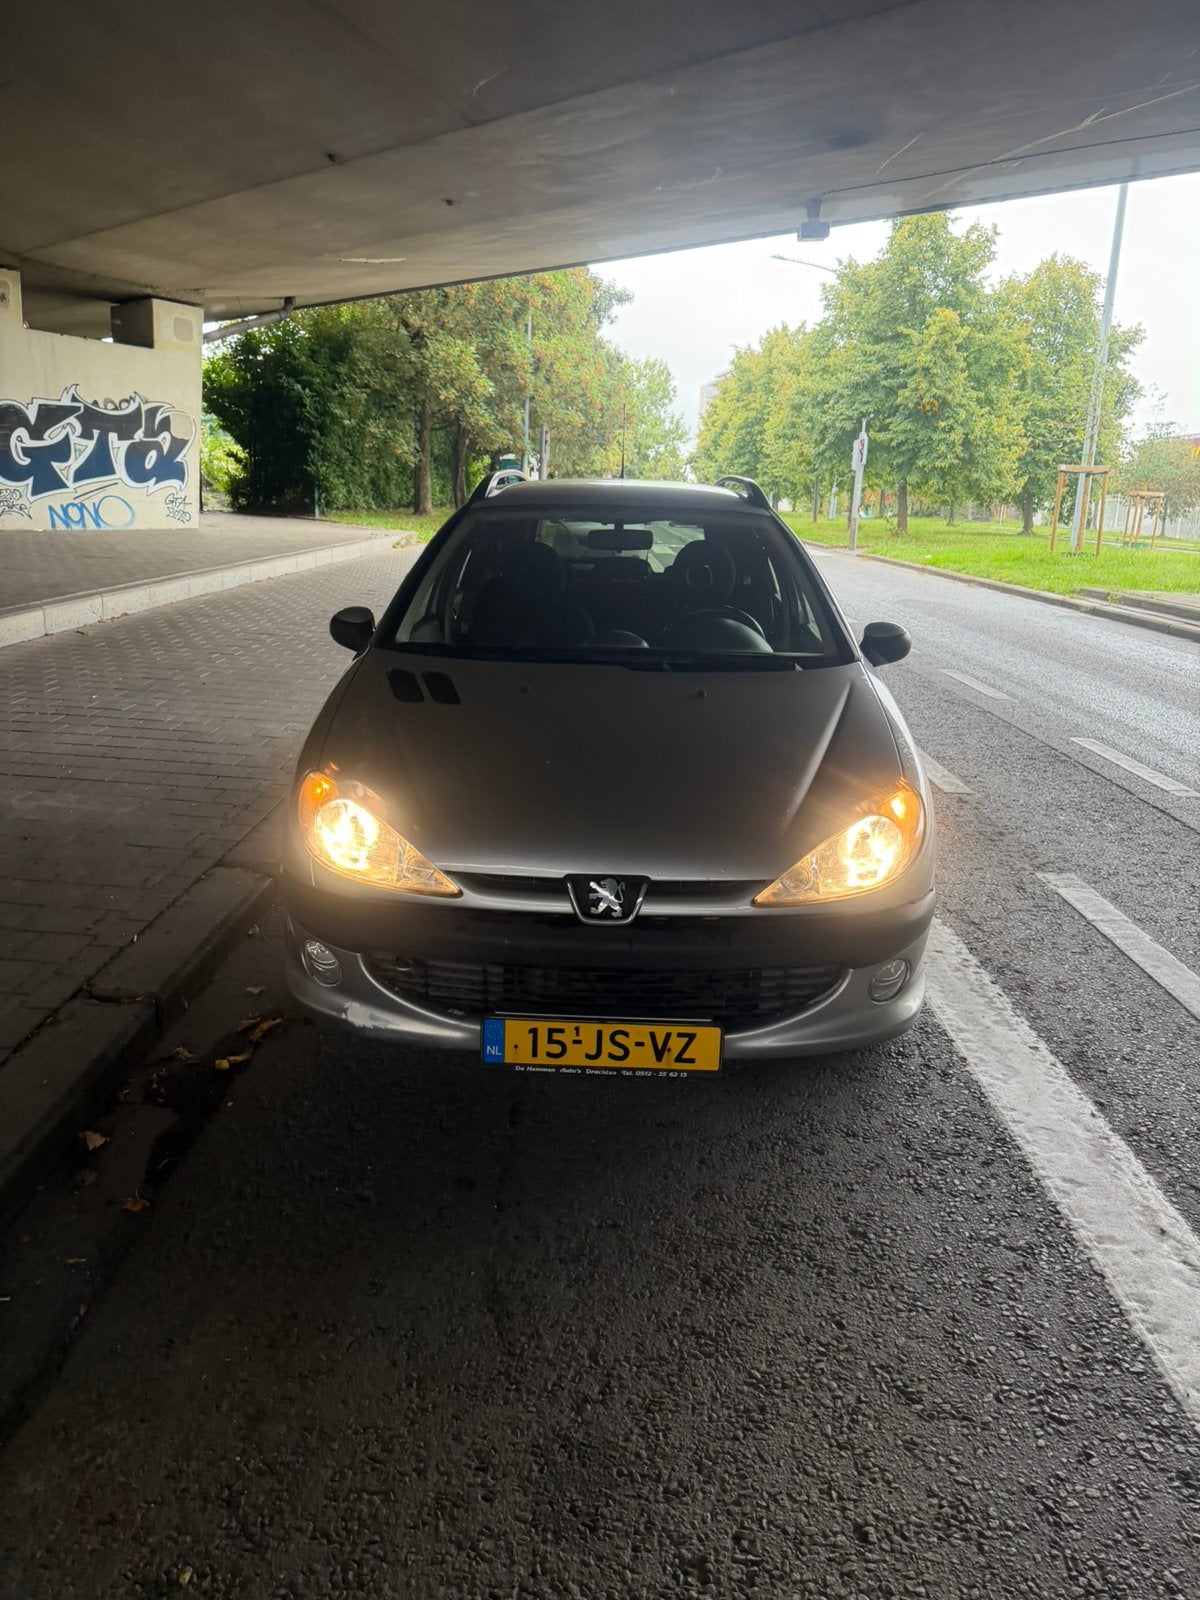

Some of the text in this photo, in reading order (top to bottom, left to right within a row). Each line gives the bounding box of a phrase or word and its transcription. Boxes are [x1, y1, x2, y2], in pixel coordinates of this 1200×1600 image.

[486, 1045, 502, 1056] NL
[528, 1026, 697, 1064] 15-JS-VZ
[586, 1068, 617, 1076] Drachten
[635, 1070, 652, 1078] 0512
[669, 1071, 679, 1079] 62
